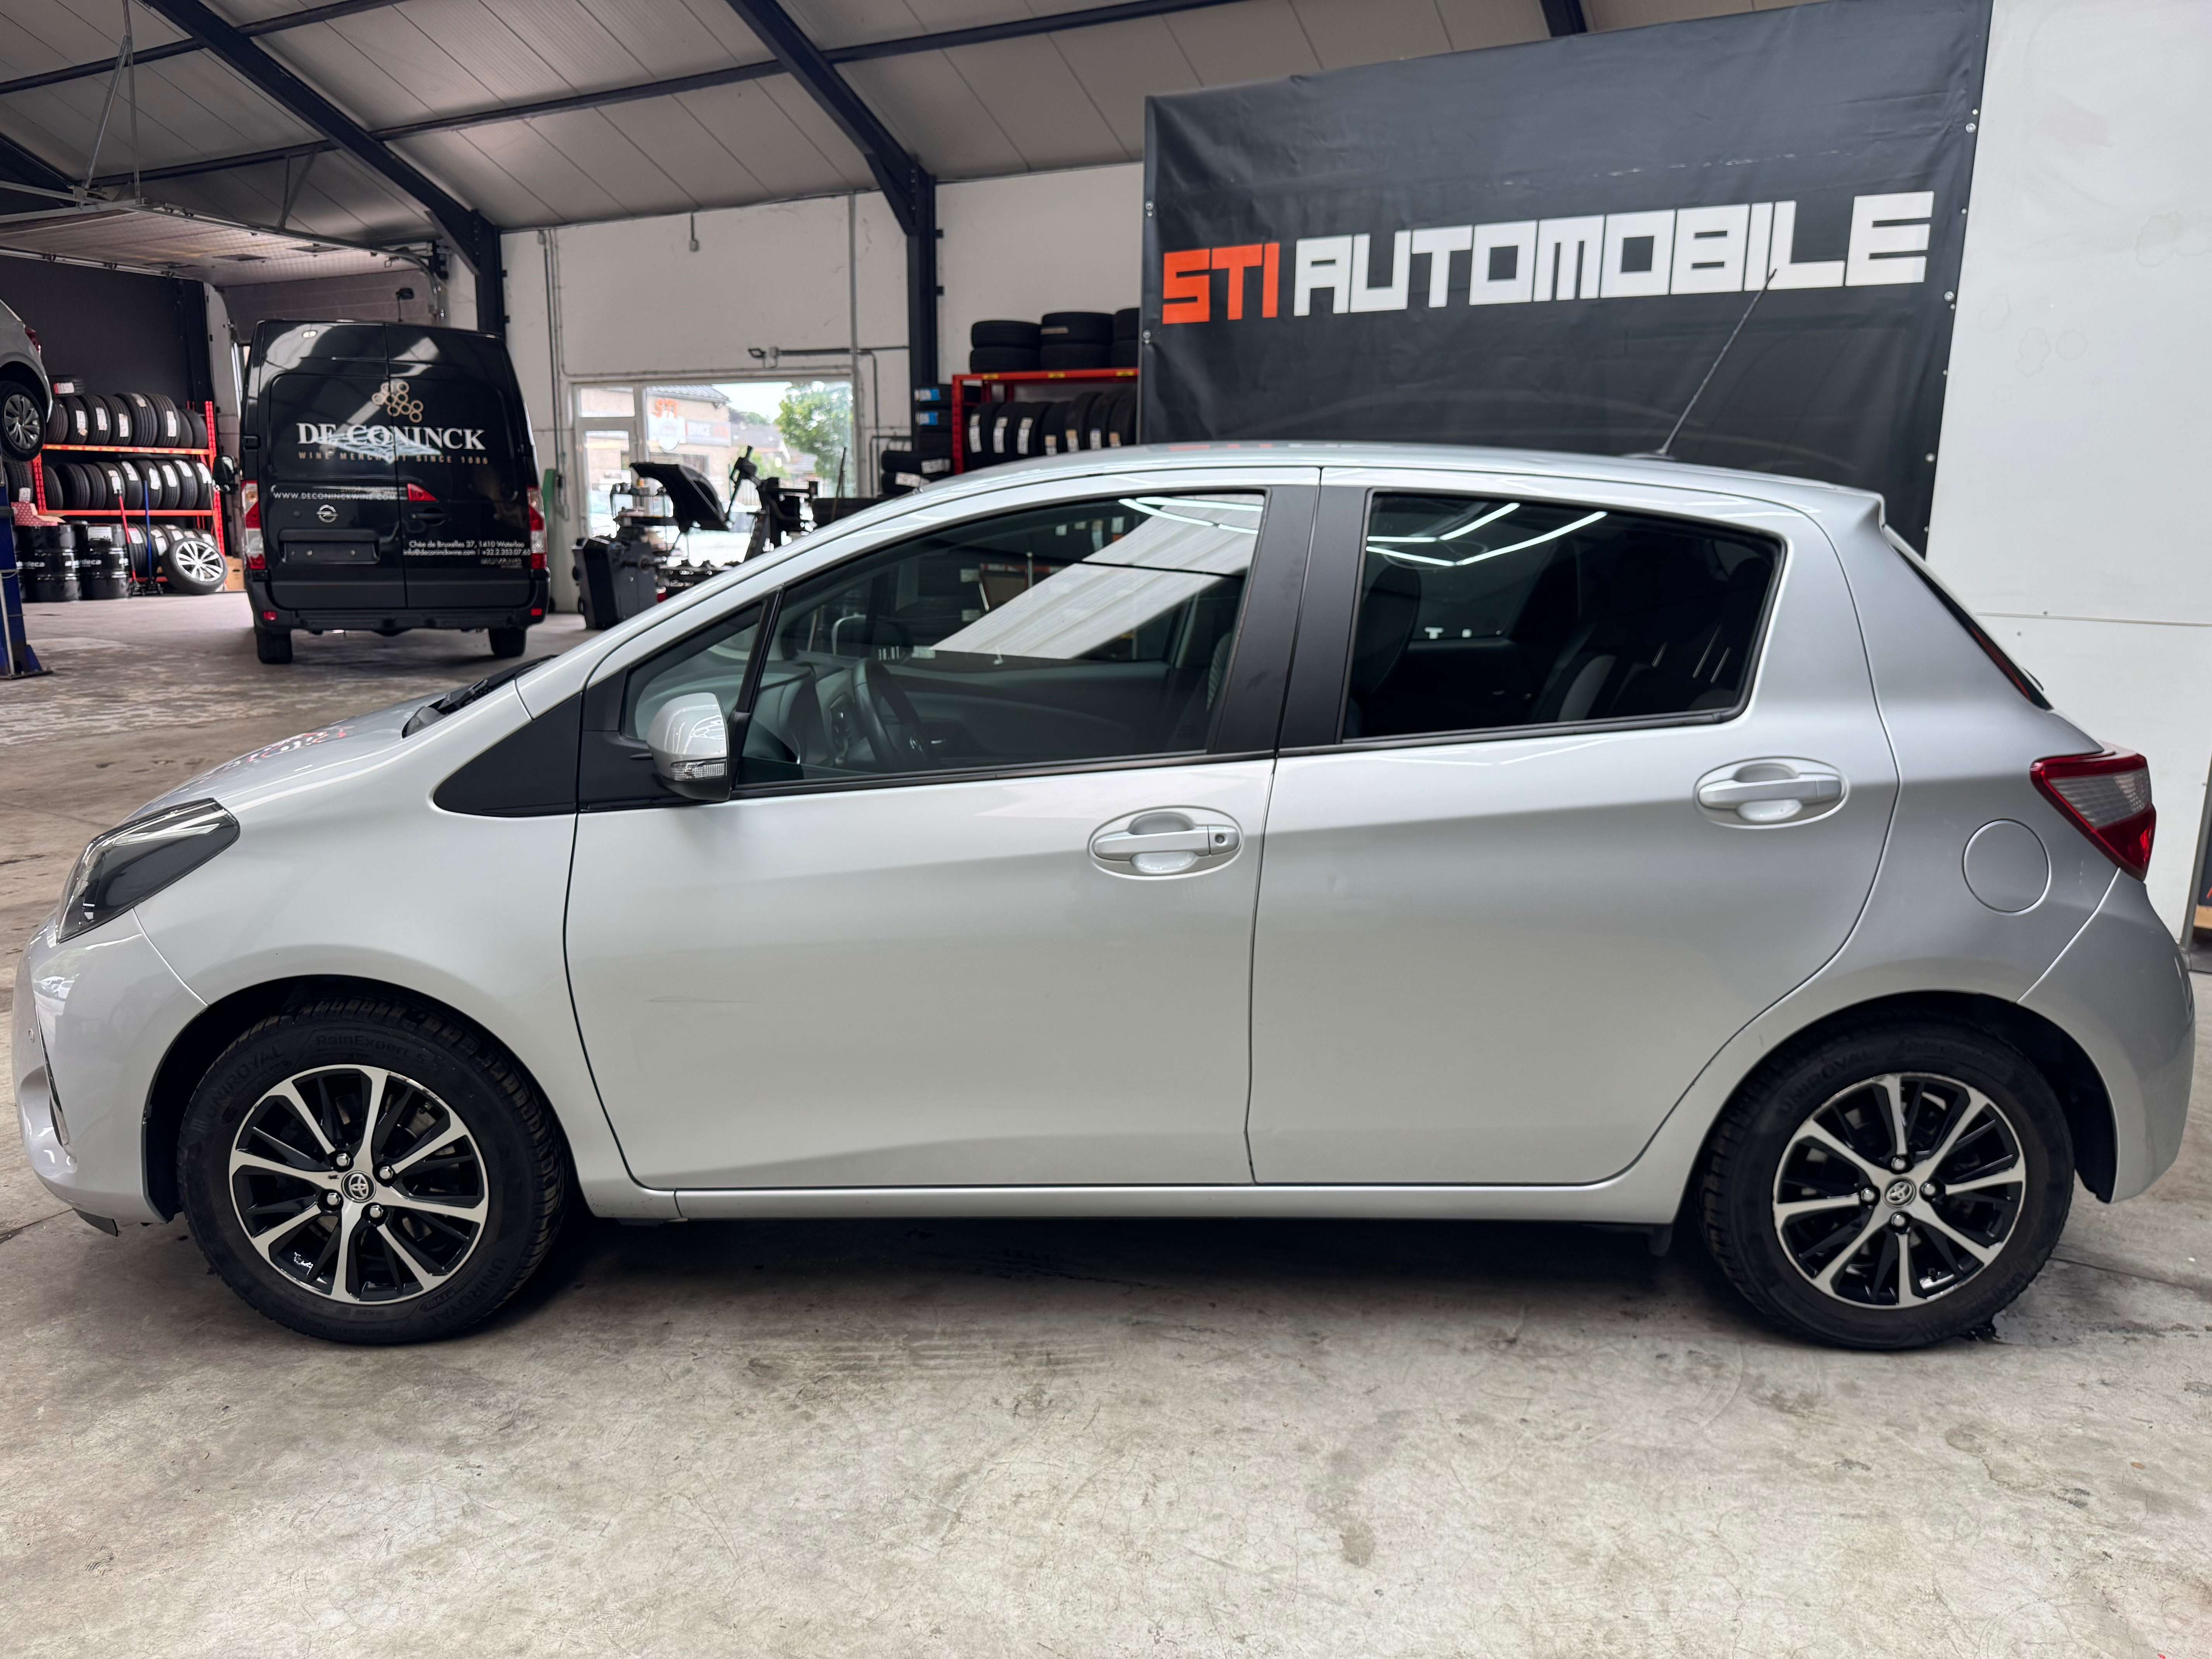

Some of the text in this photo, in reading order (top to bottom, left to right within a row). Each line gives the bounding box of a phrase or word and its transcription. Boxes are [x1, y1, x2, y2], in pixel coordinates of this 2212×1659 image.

[1163, 191, 1935, 325] STI AUTOMOBILE
[296, 422, 486, 450] DE CONINCK
